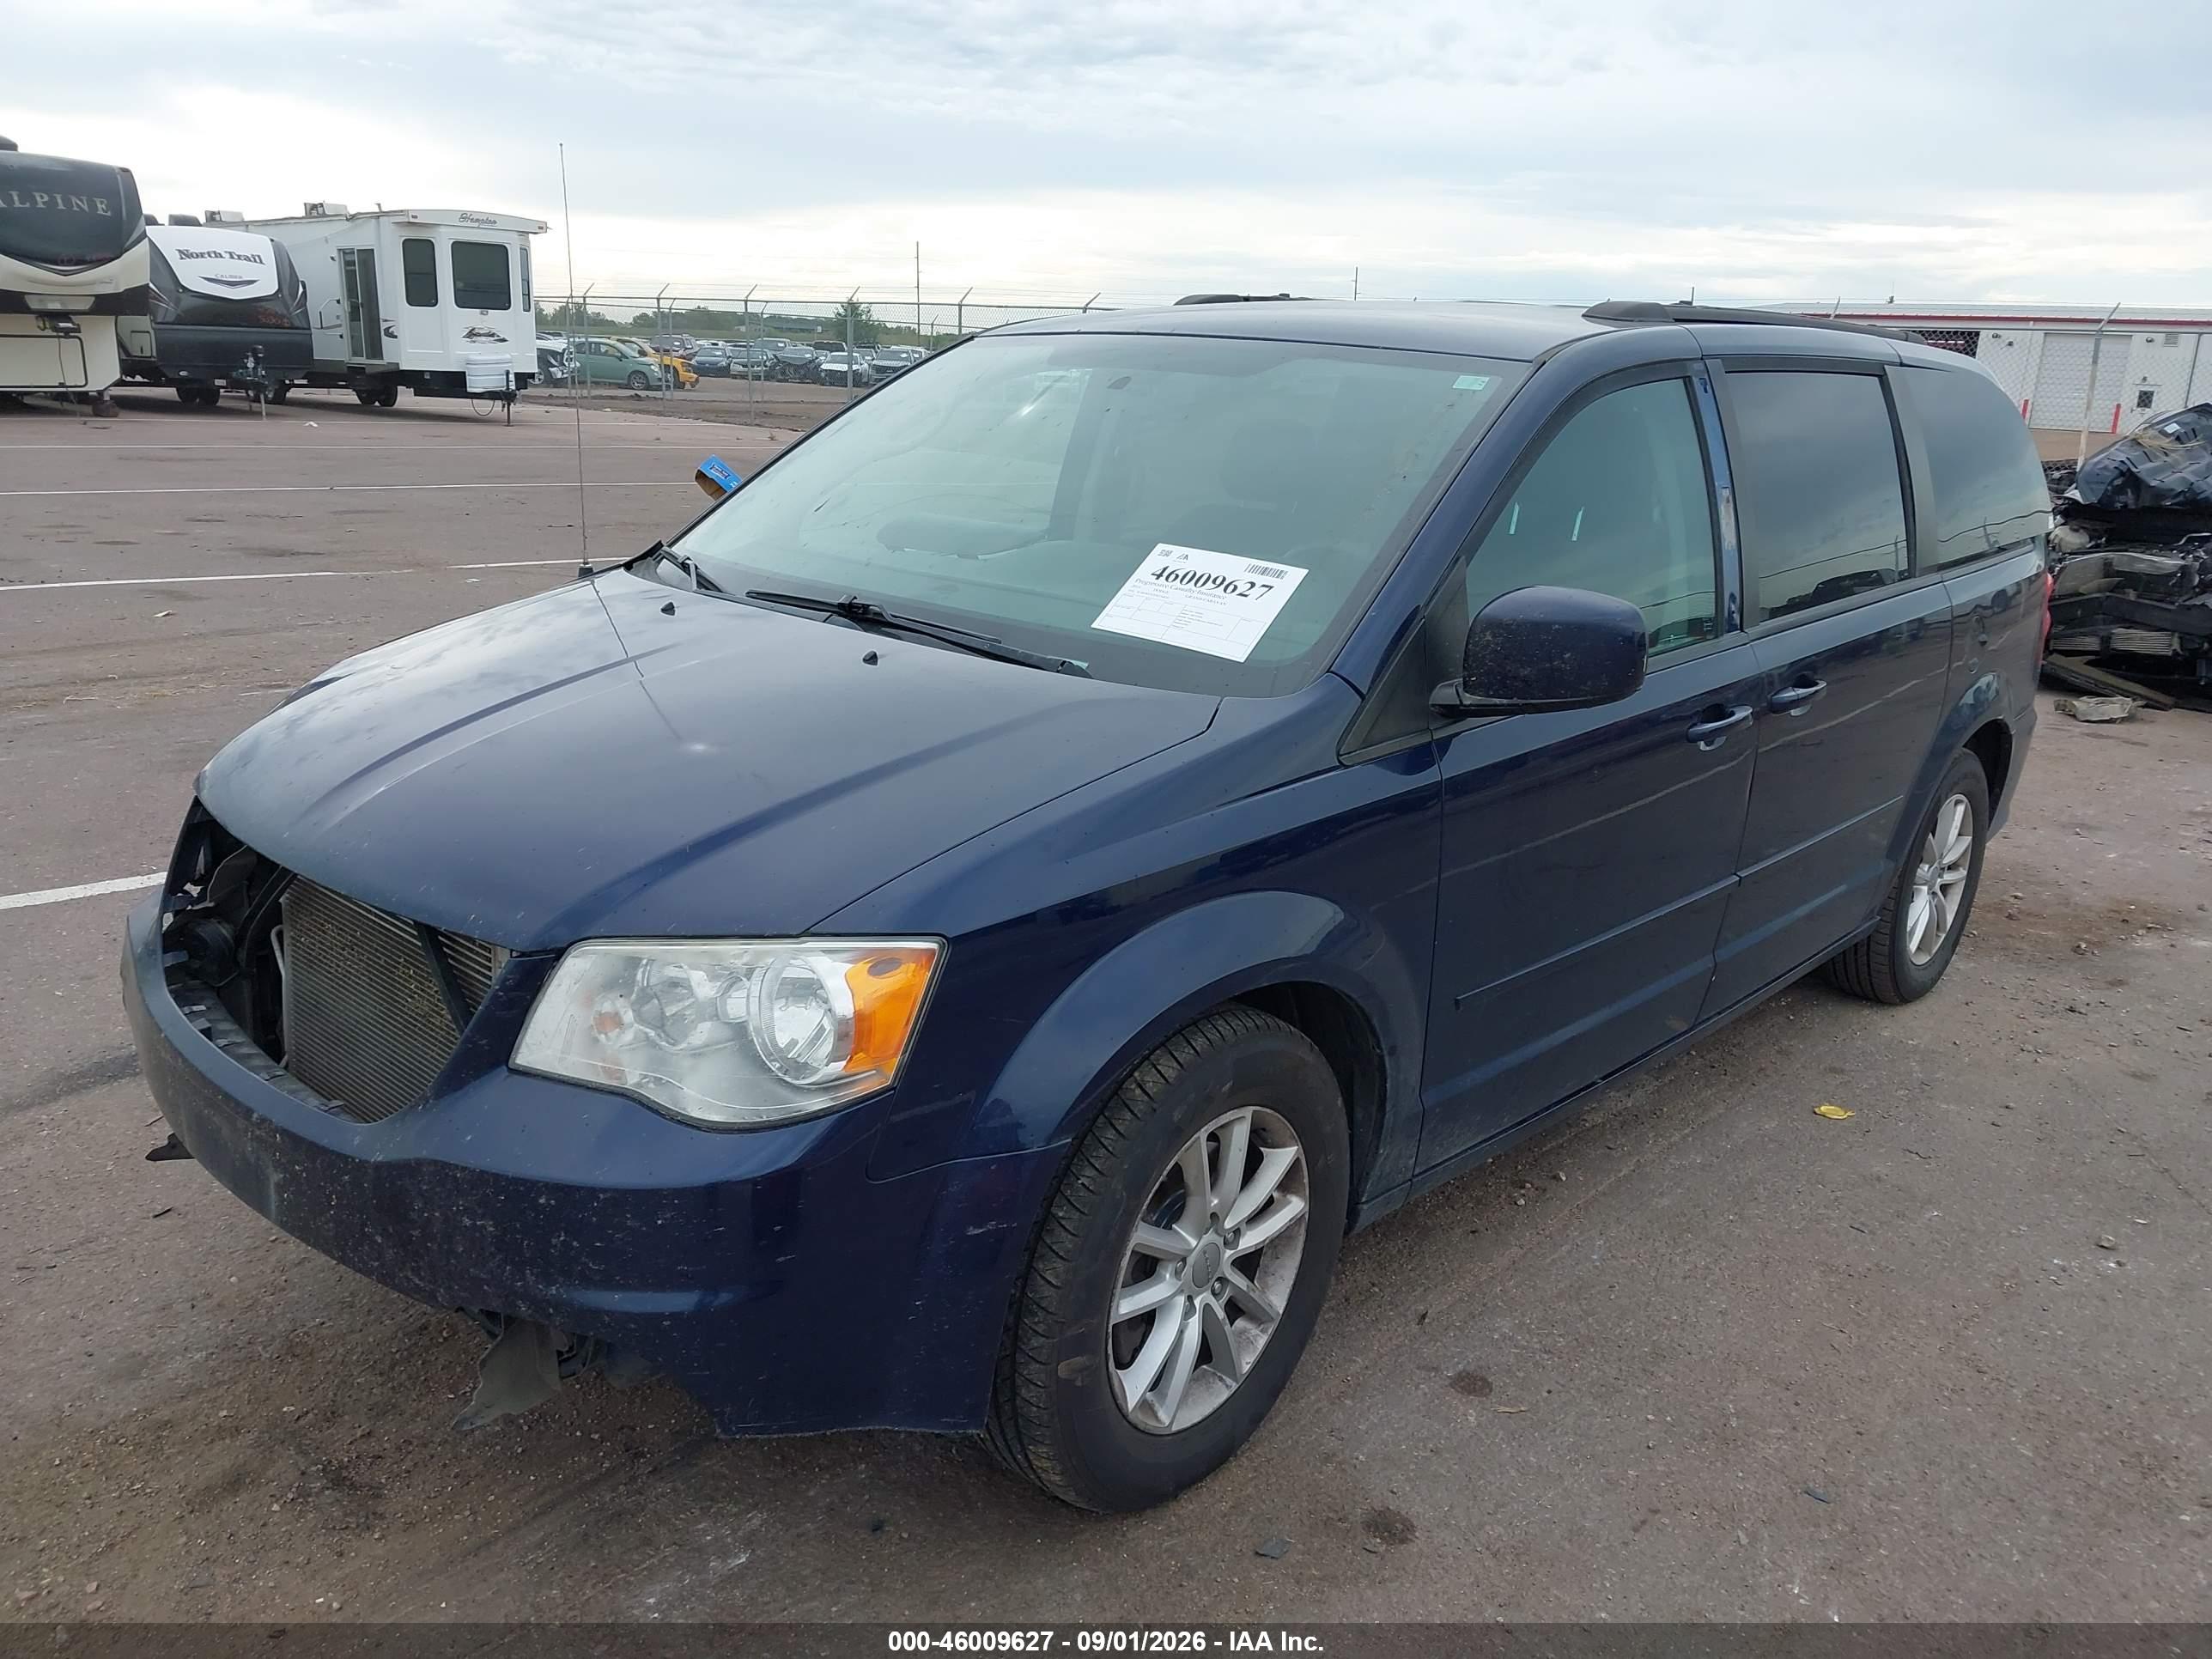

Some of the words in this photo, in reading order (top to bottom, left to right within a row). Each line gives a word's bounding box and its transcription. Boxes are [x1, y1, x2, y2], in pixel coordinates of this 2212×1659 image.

[175, 248, 225, 260] North
[224, 250, 266, 265] Trail
[1151, 565, 1275, 601] 46009627
